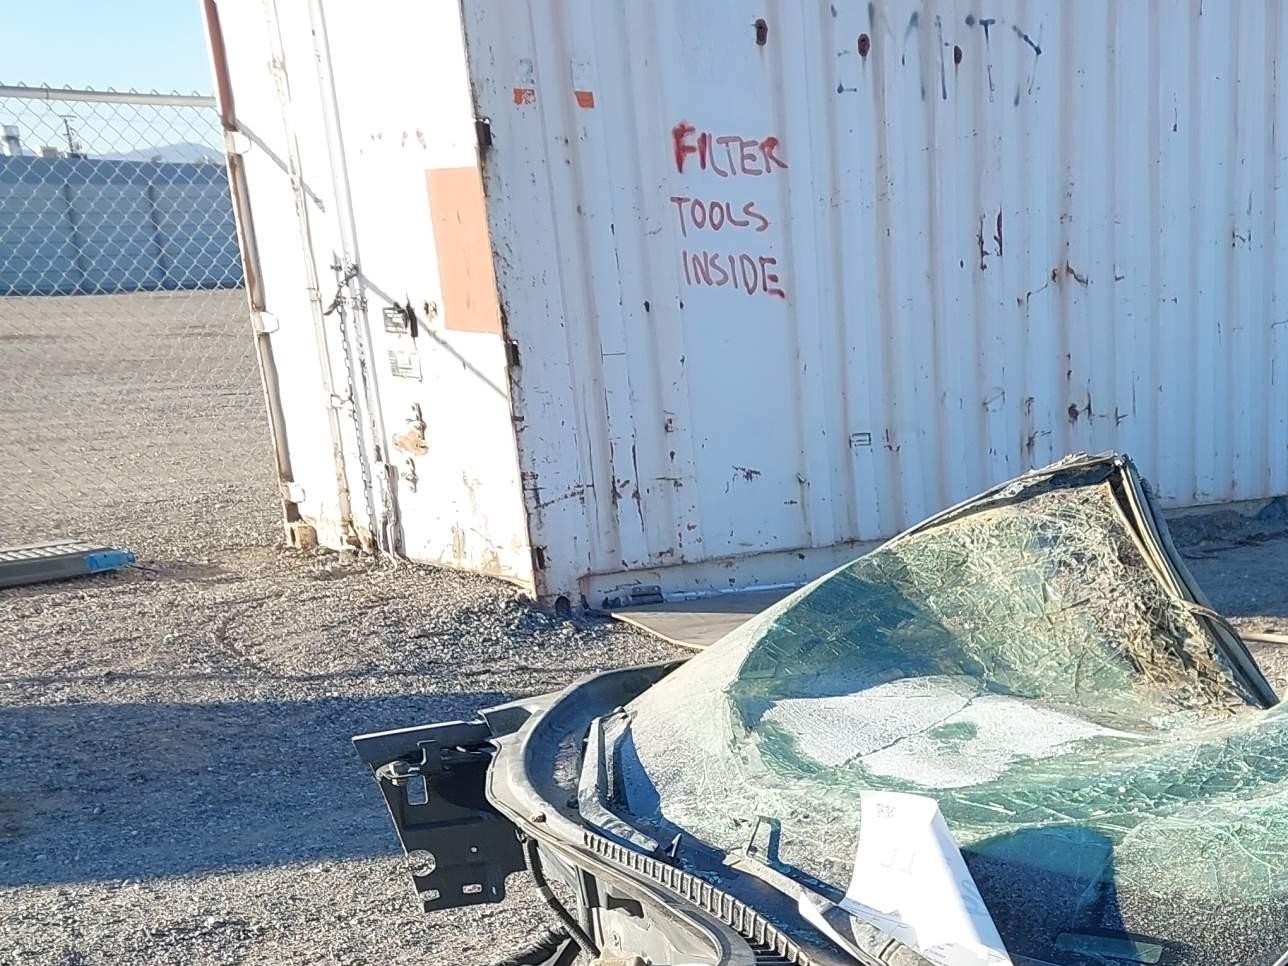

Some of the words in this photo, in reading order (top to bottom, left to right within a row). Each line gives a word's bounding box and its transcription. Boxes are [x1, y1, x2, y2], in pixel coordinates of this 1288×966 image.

[672, 123, 789, 178] FILTER
[671, 196, 769, 238] TOOLS
[682, 250, 786, 298] INSIDE
